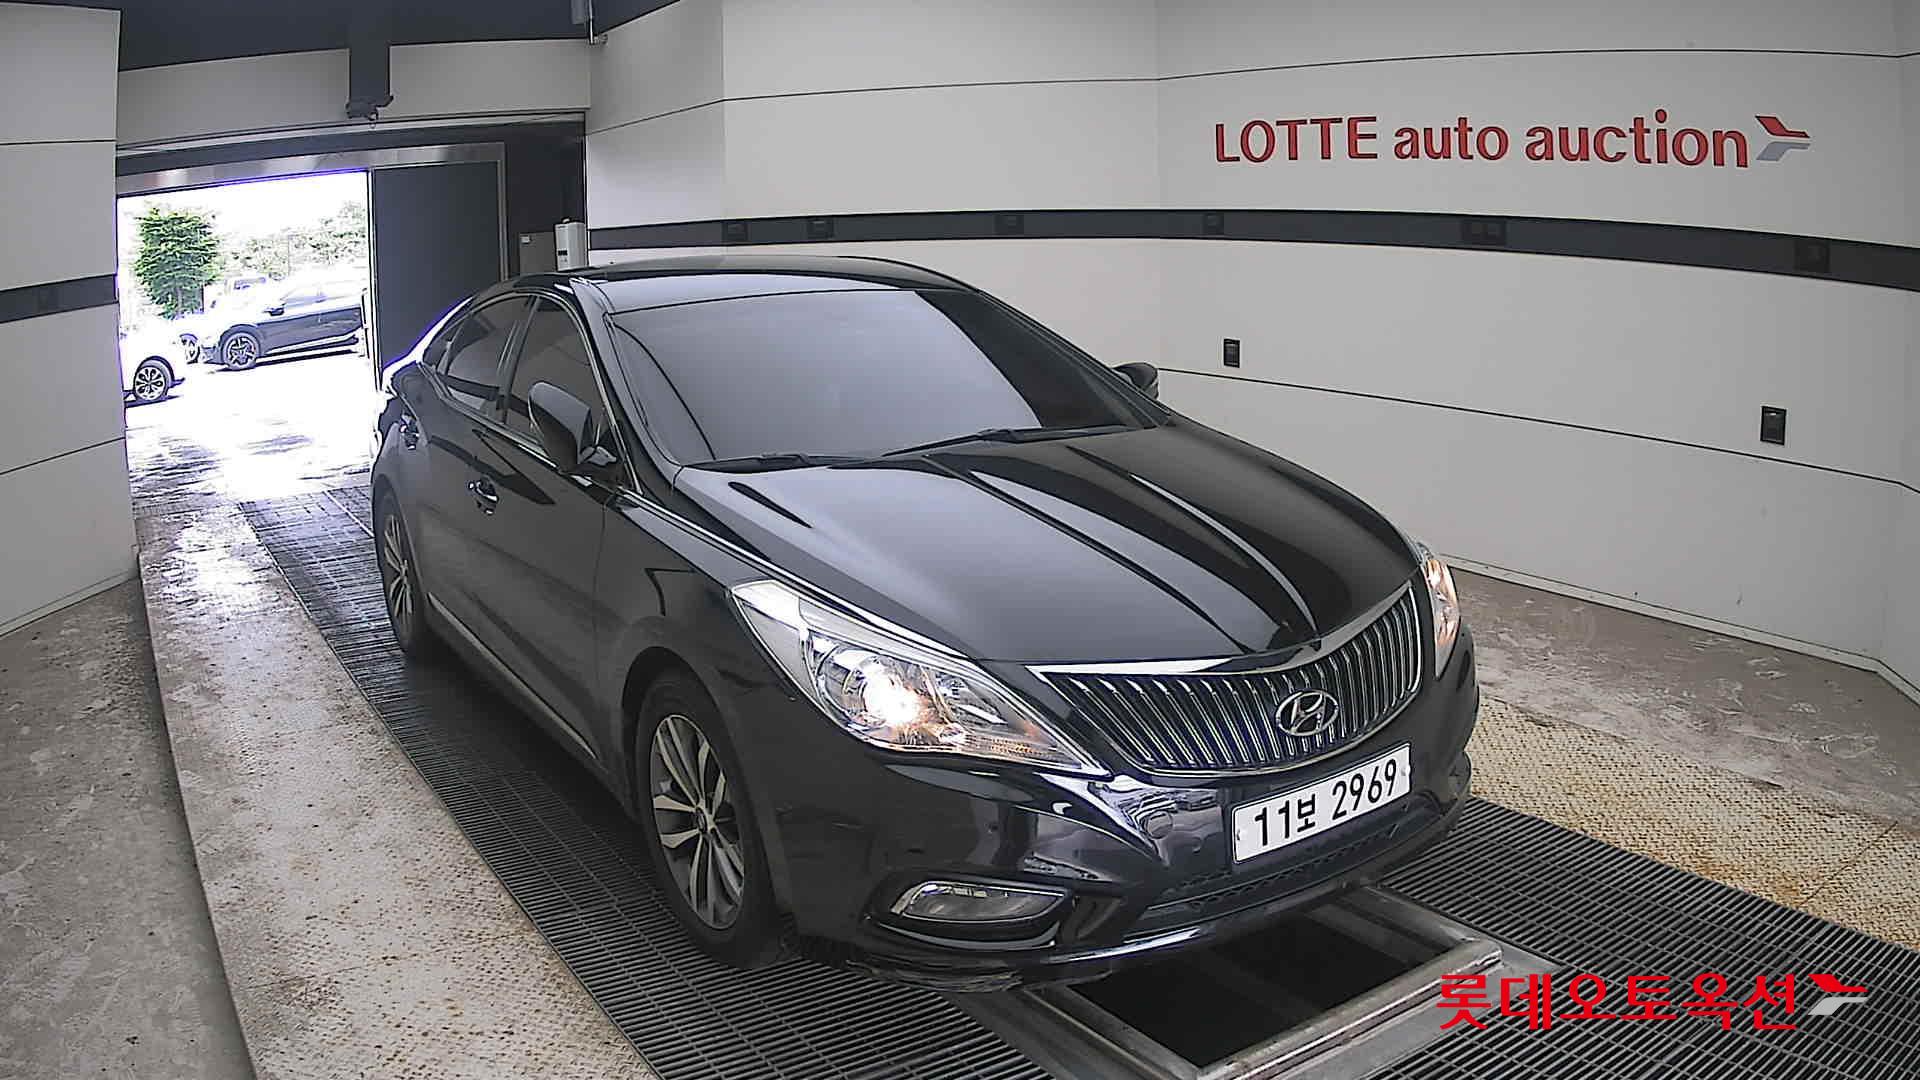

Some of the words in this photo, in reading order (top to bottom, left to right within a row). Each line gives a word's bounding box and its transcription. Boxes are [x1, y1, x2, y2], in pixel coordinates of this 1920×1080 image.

[1214, 115, 1379, 163] LOTTE
[1393, 115, 1510, 161] auto
[1524, 109, 1749, 169] auction
[1254, 793, 1317, 847] 11보
[1331, 758, 1397, 821] 2969
